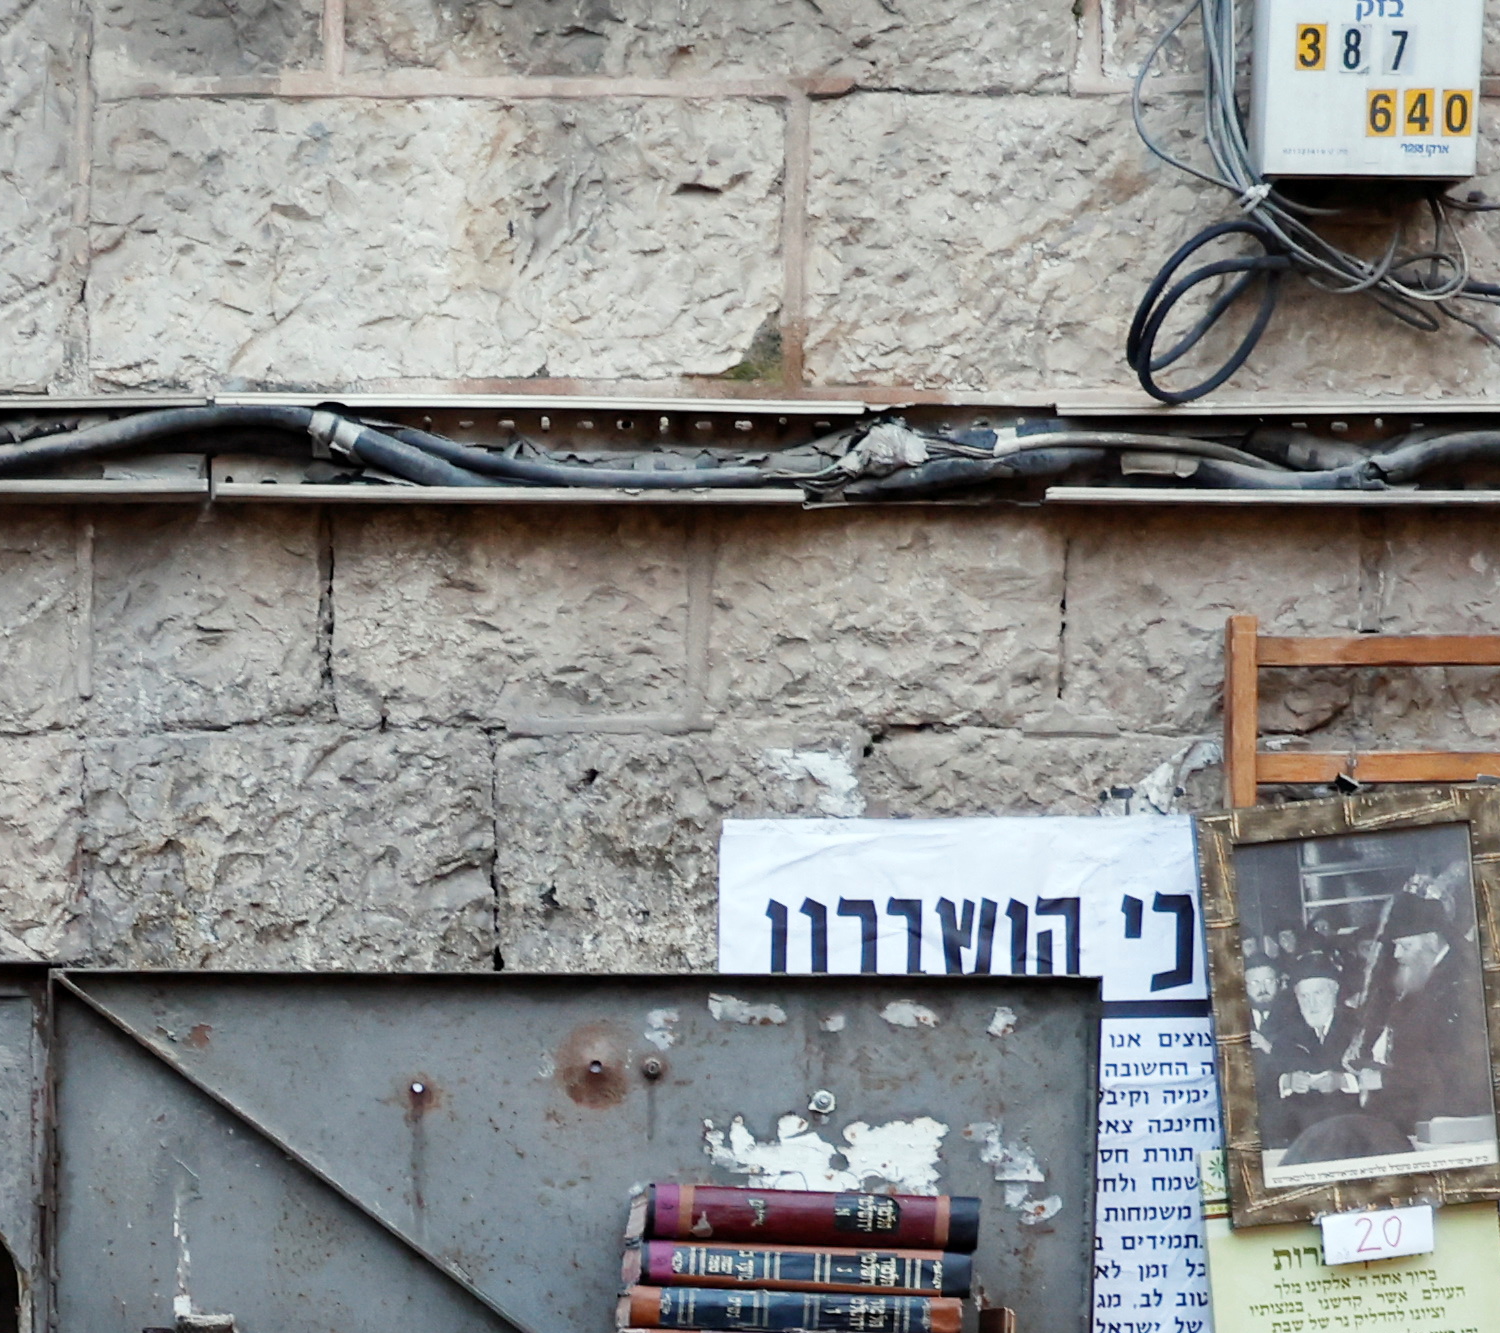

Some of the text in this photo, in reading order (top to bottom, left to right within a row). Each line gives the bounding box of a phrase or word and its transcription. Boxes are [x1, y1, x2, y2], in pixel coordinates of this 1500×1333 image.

[1369, 92, 1468, 133] 640
[1121, 890, 1196, 993] כי
[1109, 1033, 1141, 1048] אנו
[1104, 1059, 1189, 1080] החשובה
[1104, 1205, 1192, 1223] משמחות
[1355, 1215, 1402, 1253] 20
[1138, 1263, 1168, 1282] זמן
[1372, 1274, 1402, 1287] אתה
[1405, 1268, 1437, 1285] ברוך
[1275, 1278, 1301, 1297] מלך
[1305, 1273, 1351, 1293] אלקינו
[1272, 1320, 1304, 1333] שבת
[1308, 1313, 1330, 1330] של
[1336, 1316, 1350, 1328] נר
[1355, 1306, 1405, 1328] להדליק
